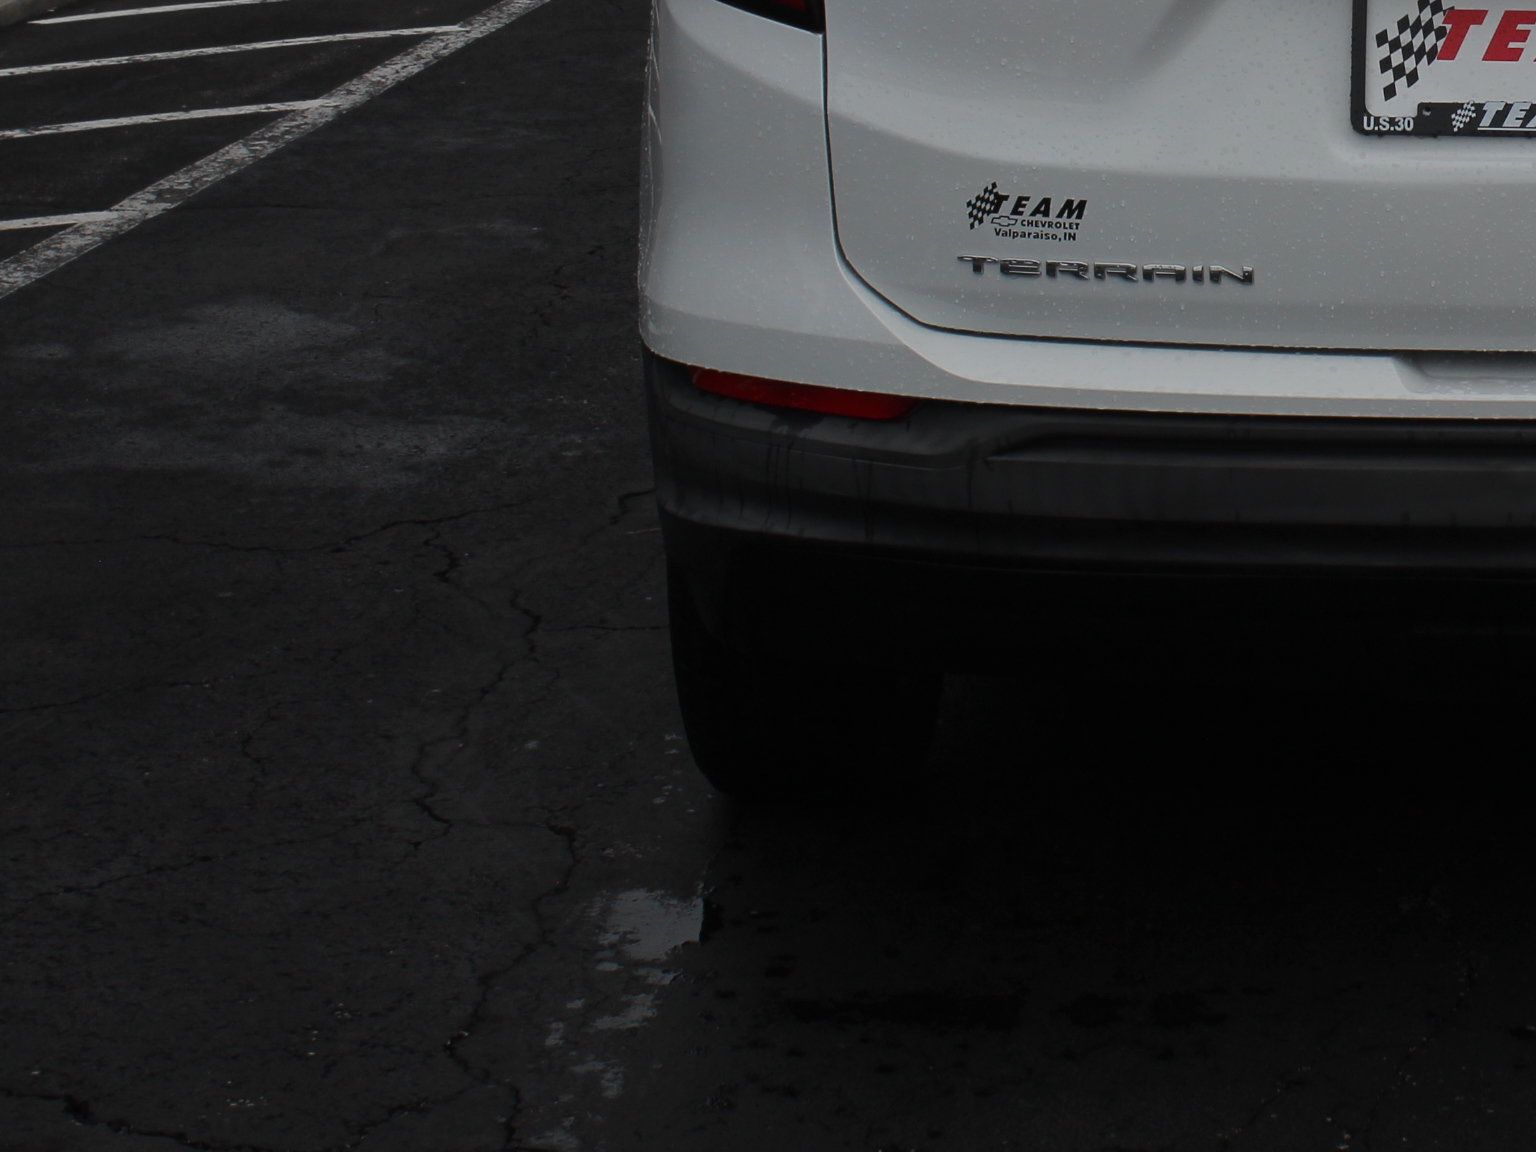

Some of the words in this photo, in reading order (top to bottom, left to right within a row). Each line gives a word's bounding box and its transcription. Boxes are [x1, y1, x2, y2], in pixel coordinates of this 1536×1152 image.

[988, 193, 1088, 221] TEAM
[994, 228, 1062, 243] Valparaiso,
[1063, 231, 1077, 242] IN
[1020, 219, 1080, 231] CHEVROLET
[956, 254, 1256, 285] TERRAIN
